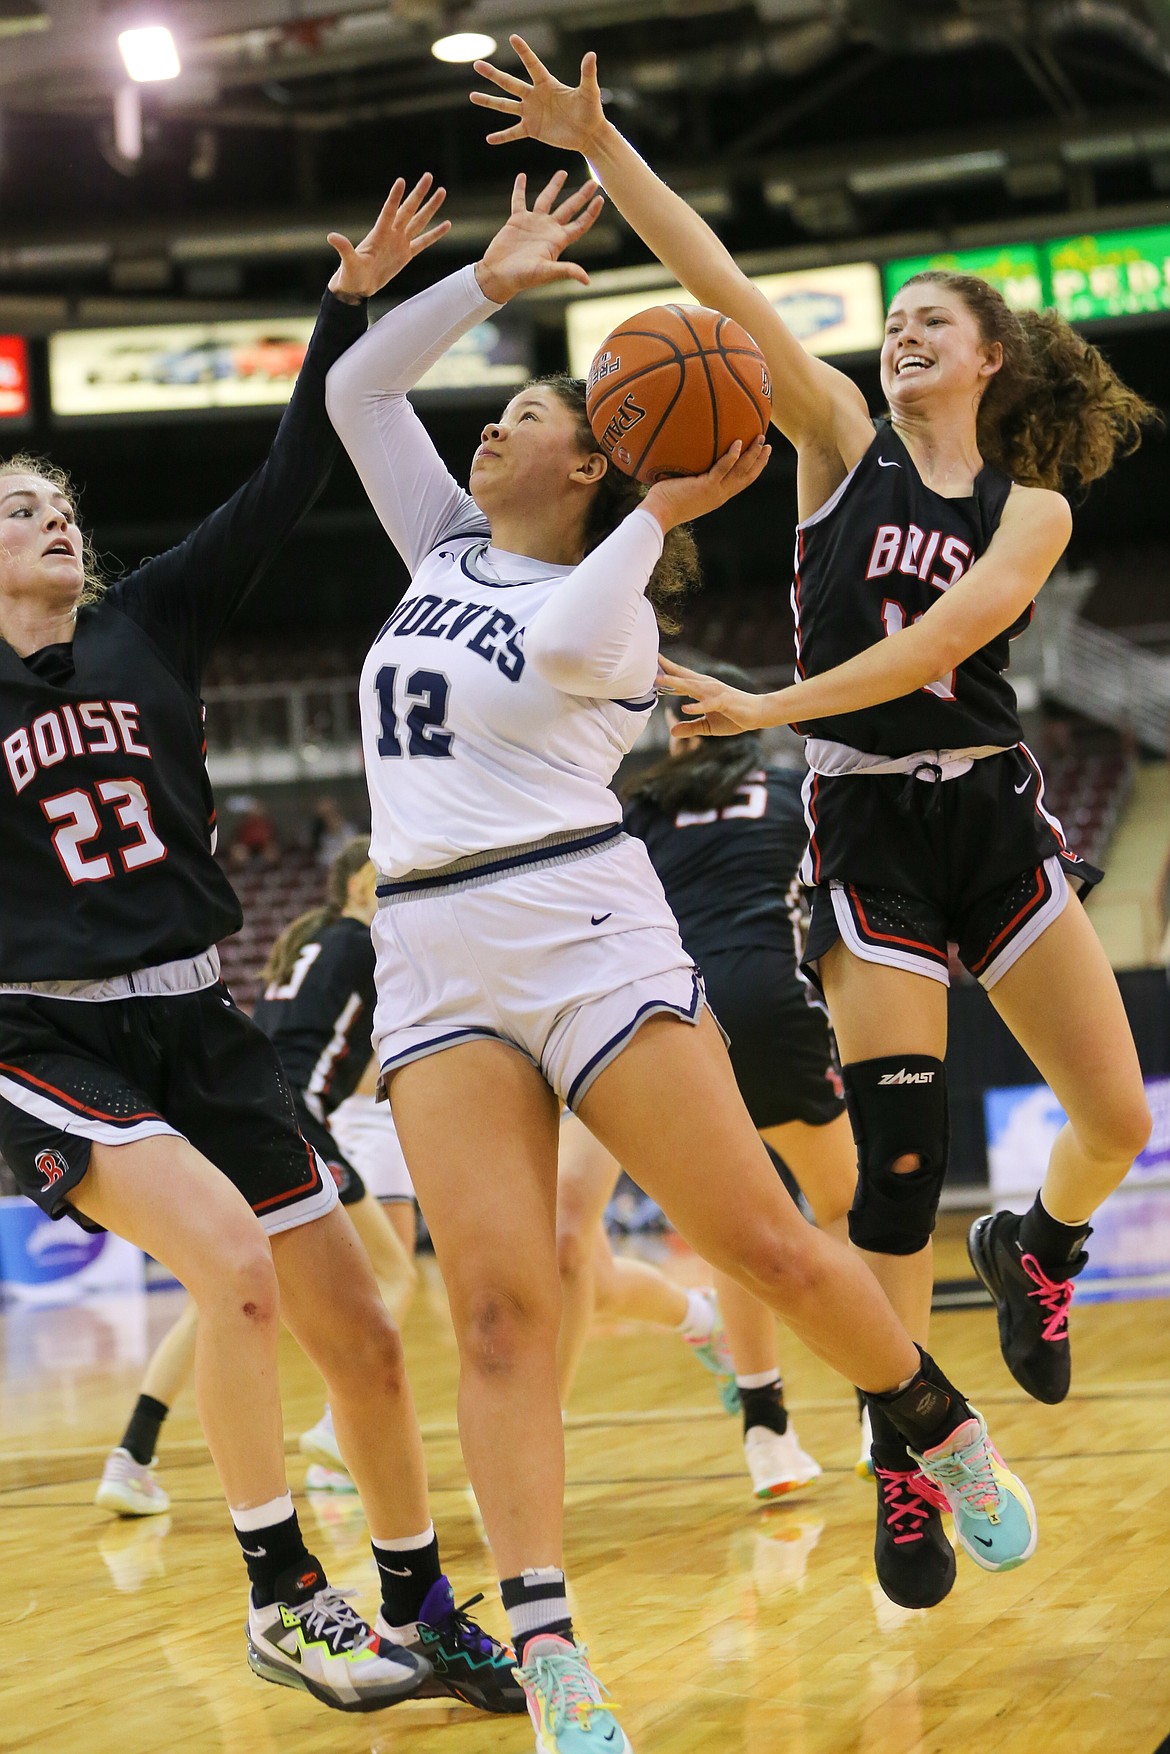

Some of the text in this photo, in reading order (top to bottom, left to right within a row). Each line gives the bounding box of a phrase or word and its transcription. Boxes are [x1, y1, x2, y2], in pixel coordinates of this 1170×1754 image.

[1052, 257, 1170, 303] PED
[865, 522, 976, 592] BOIS
[2, 700, 152, 796] BOISE
[373, 663, 456, 760] 12
[39, 776, 168, 886] 23
[877, 1067, 935, 1085] ZAMST
